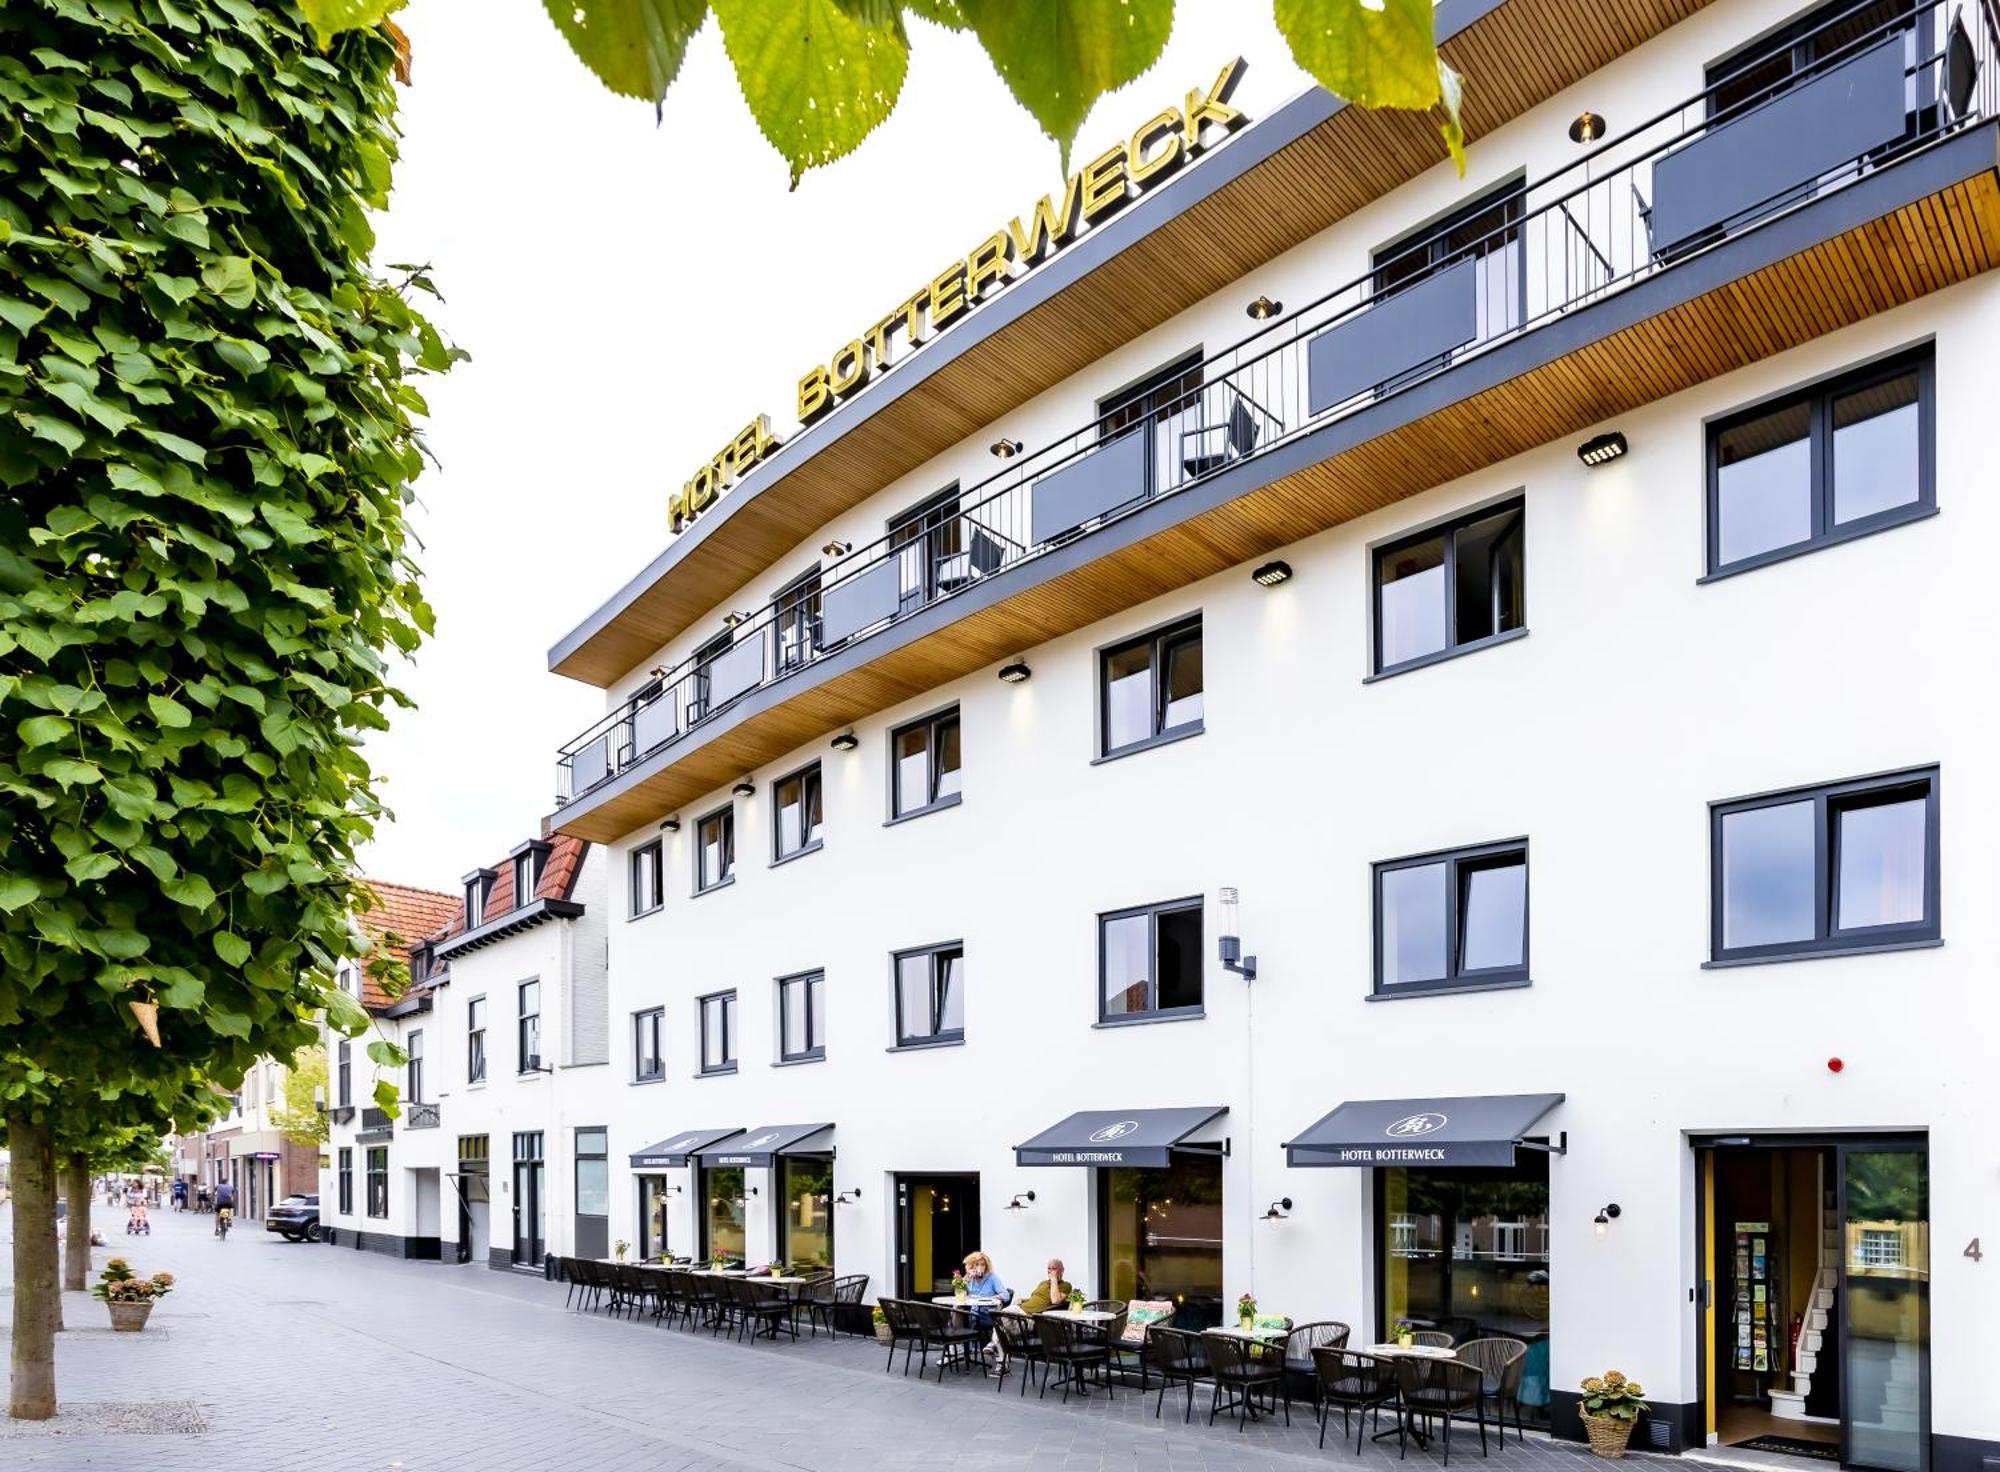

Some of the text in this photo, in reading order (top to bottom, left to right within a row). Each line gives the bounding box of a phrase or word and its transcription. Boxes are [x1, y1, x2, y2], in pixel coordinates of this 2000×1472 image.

[668, 55, 1250, 534] HOTEL BOTTERWECK
[1052, 1153, 1123, 1162] HOTEL BOTTERWECK
[1341, 1149, 1445, 1161] HOTEL BOTTERWECK
[1963, 1237, 1983, 1262] 4
